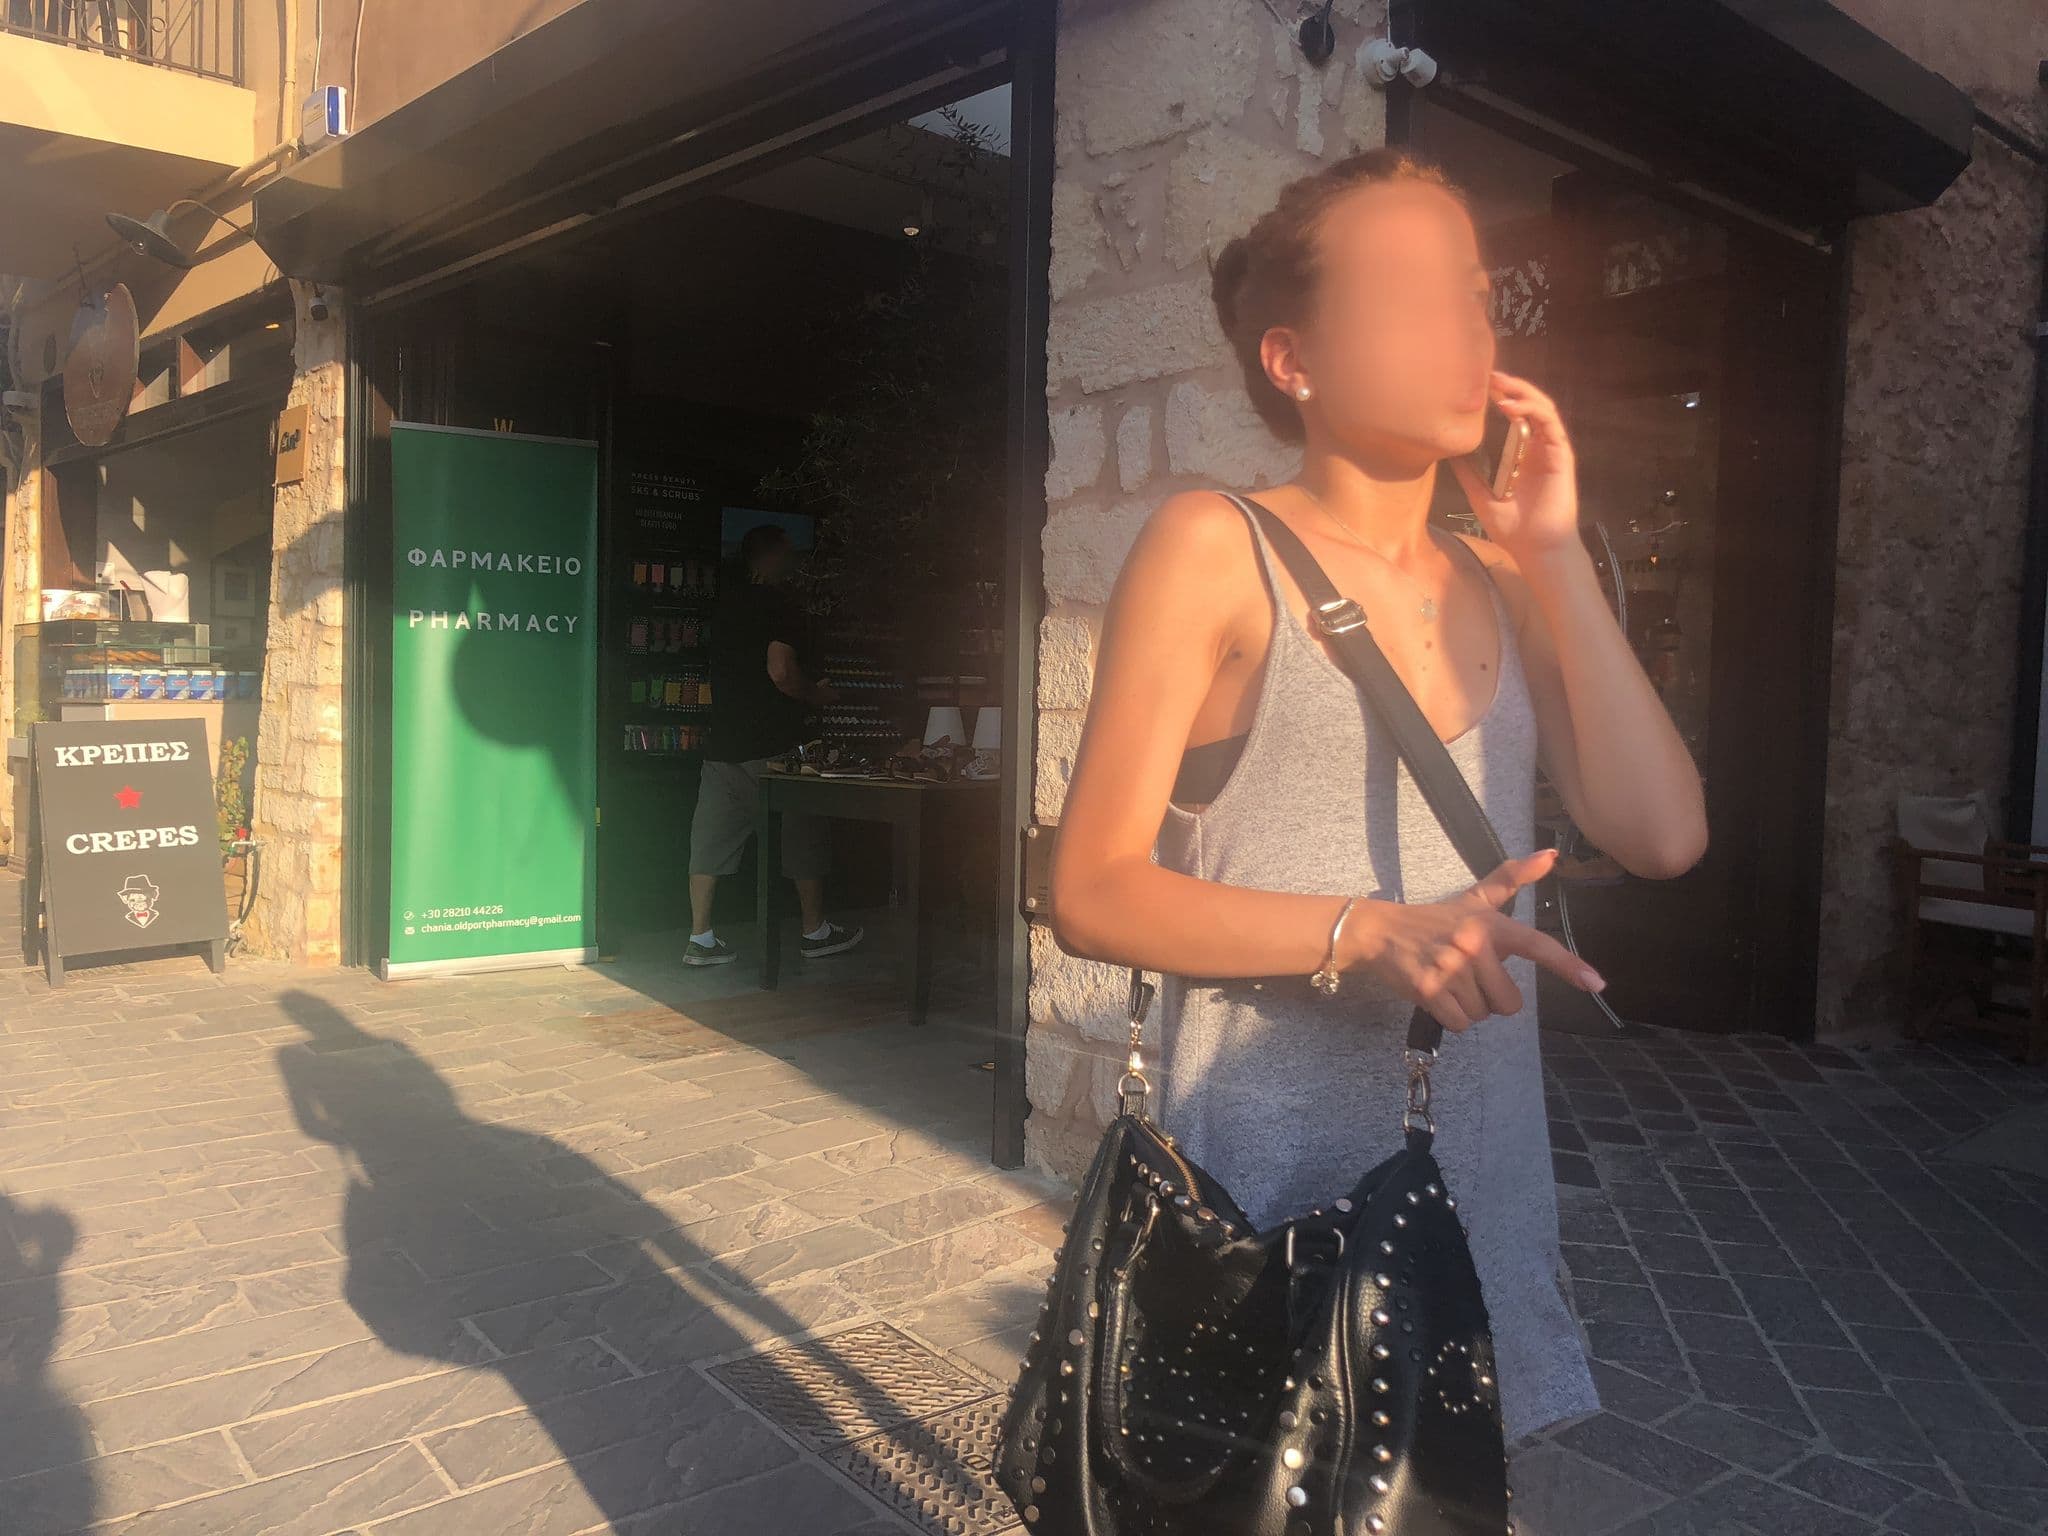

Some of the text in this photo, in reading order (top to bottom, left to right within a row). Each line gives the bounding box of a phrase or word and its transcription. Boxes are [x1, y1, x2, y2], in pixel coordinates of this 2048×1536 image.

[662, 489, 701, 501] SCRUBS
[407, 547, 582, 575] ΦΑΡΜΑΚΕΙΟ
[409, 609, 578, 634] PHARMACY
[54, 741, 190, 767] ΚΡΕΠΕΣ
[65, 825, 199, 855] CREPES
[421, 905, 504, 920] +30 28210 44226
[421, 914, 582, 933] chania.oldportpharmacy@gmail.com
